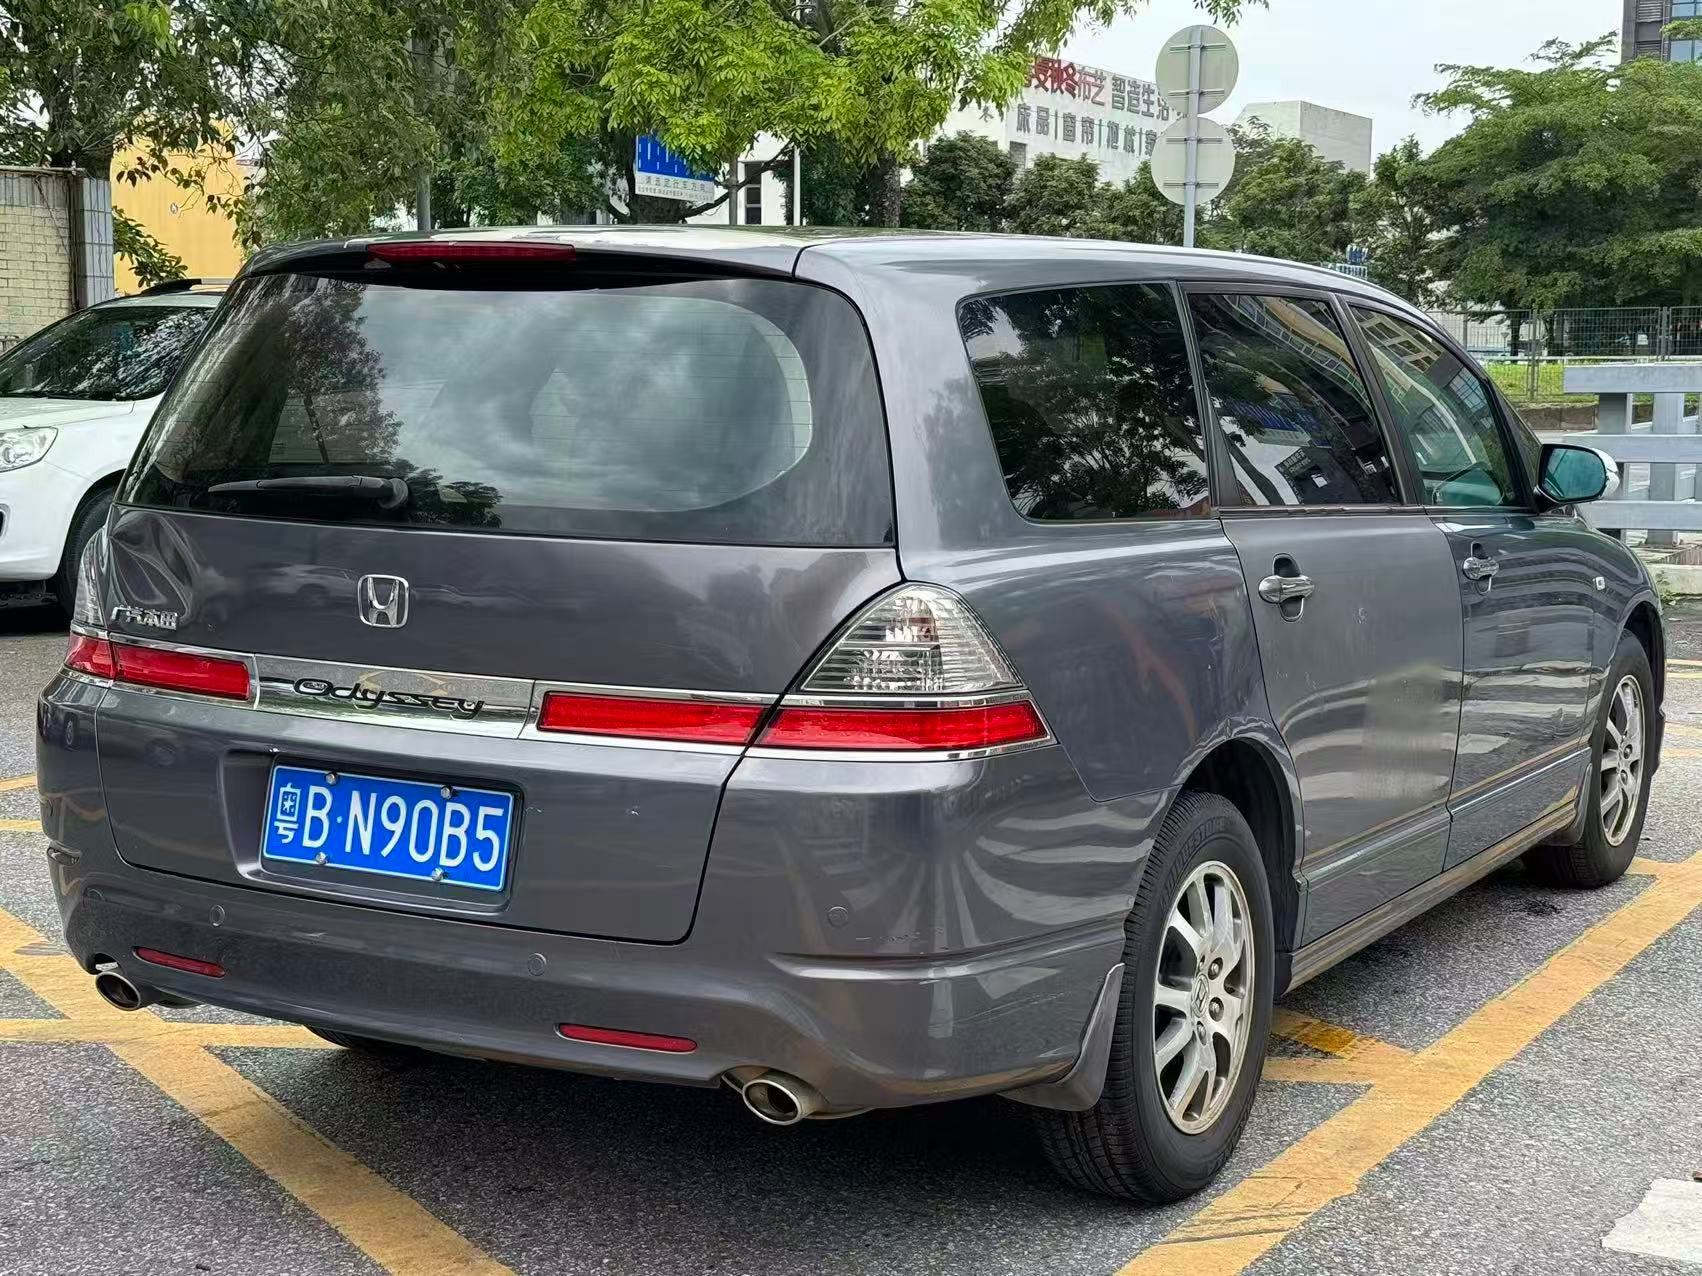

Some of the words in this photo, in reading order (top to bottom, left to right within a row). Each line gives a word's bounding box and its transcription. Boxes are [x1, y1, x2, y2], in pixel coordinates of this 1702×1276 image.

[1026, 57, 1107, 106] 夏秋冬布艺
[293, 678, 485, 720] Odyssey
